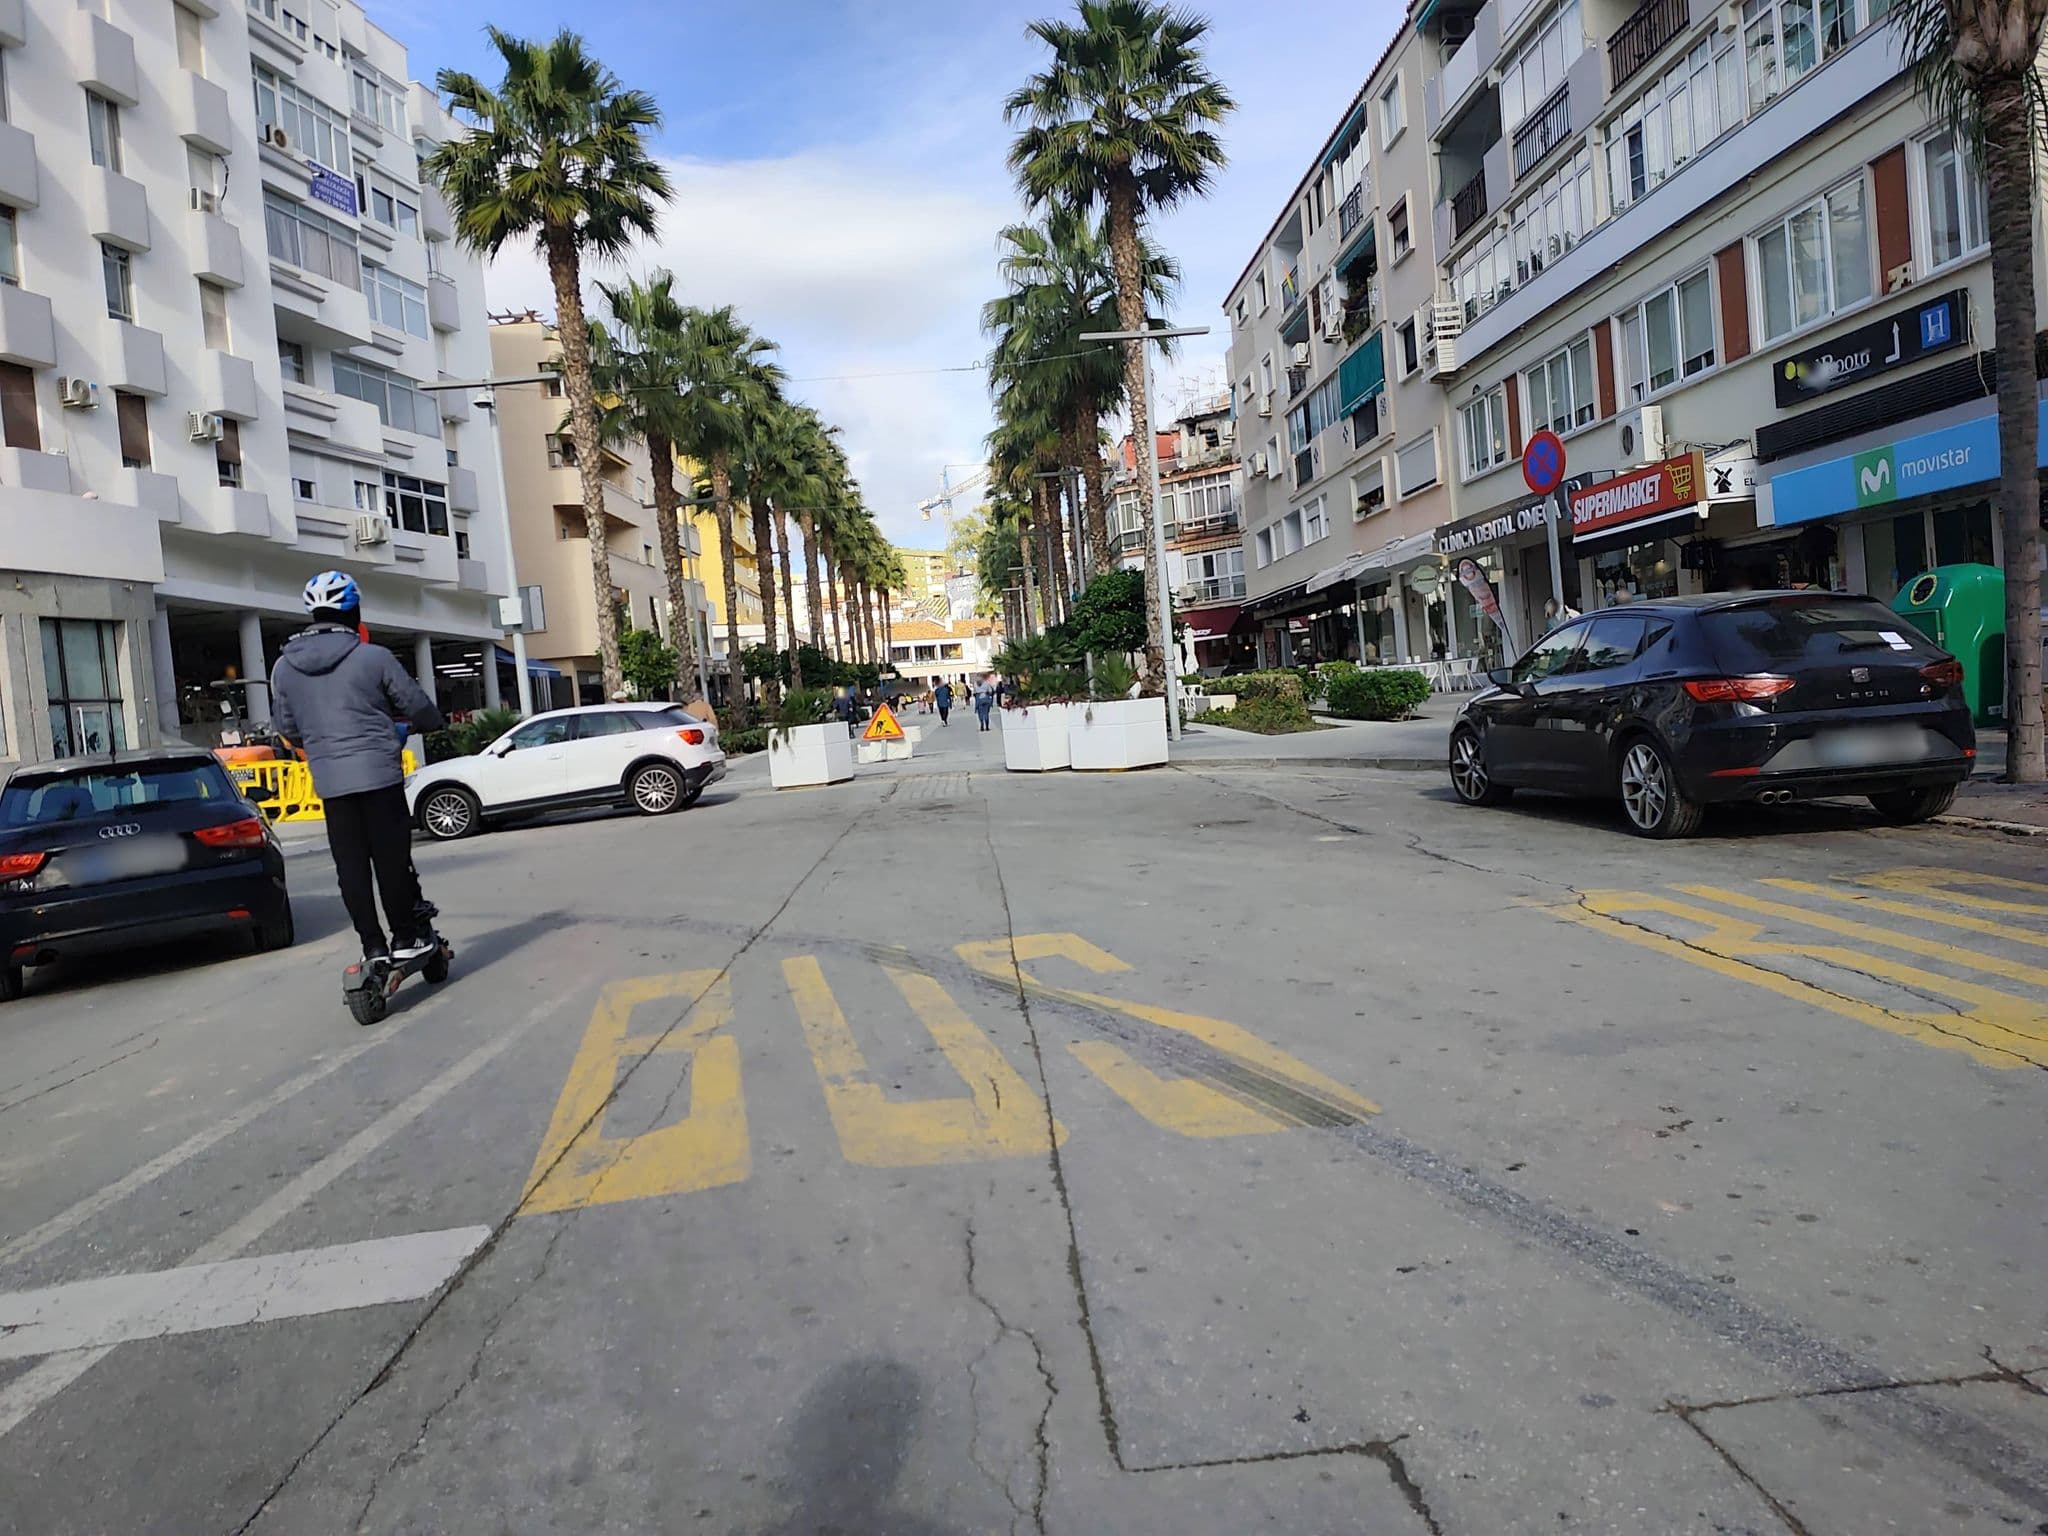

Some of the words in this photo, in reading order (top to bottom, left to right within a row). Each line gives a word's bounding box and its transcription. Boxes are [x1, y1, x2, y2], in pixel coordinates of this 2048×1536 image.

[1926, 309, 1945, 342] H
[1902, 447, 1971, 479] movistar
[1574, 474, 1661, 525] SUPERMARKET
[1438, 530, 1475, 554] CLÍNICA
[1475, 514, 1516, 544] DENTAL
[1517, 500, 1562, 532] OME
[517, 932, 1380, 1217] BUS
